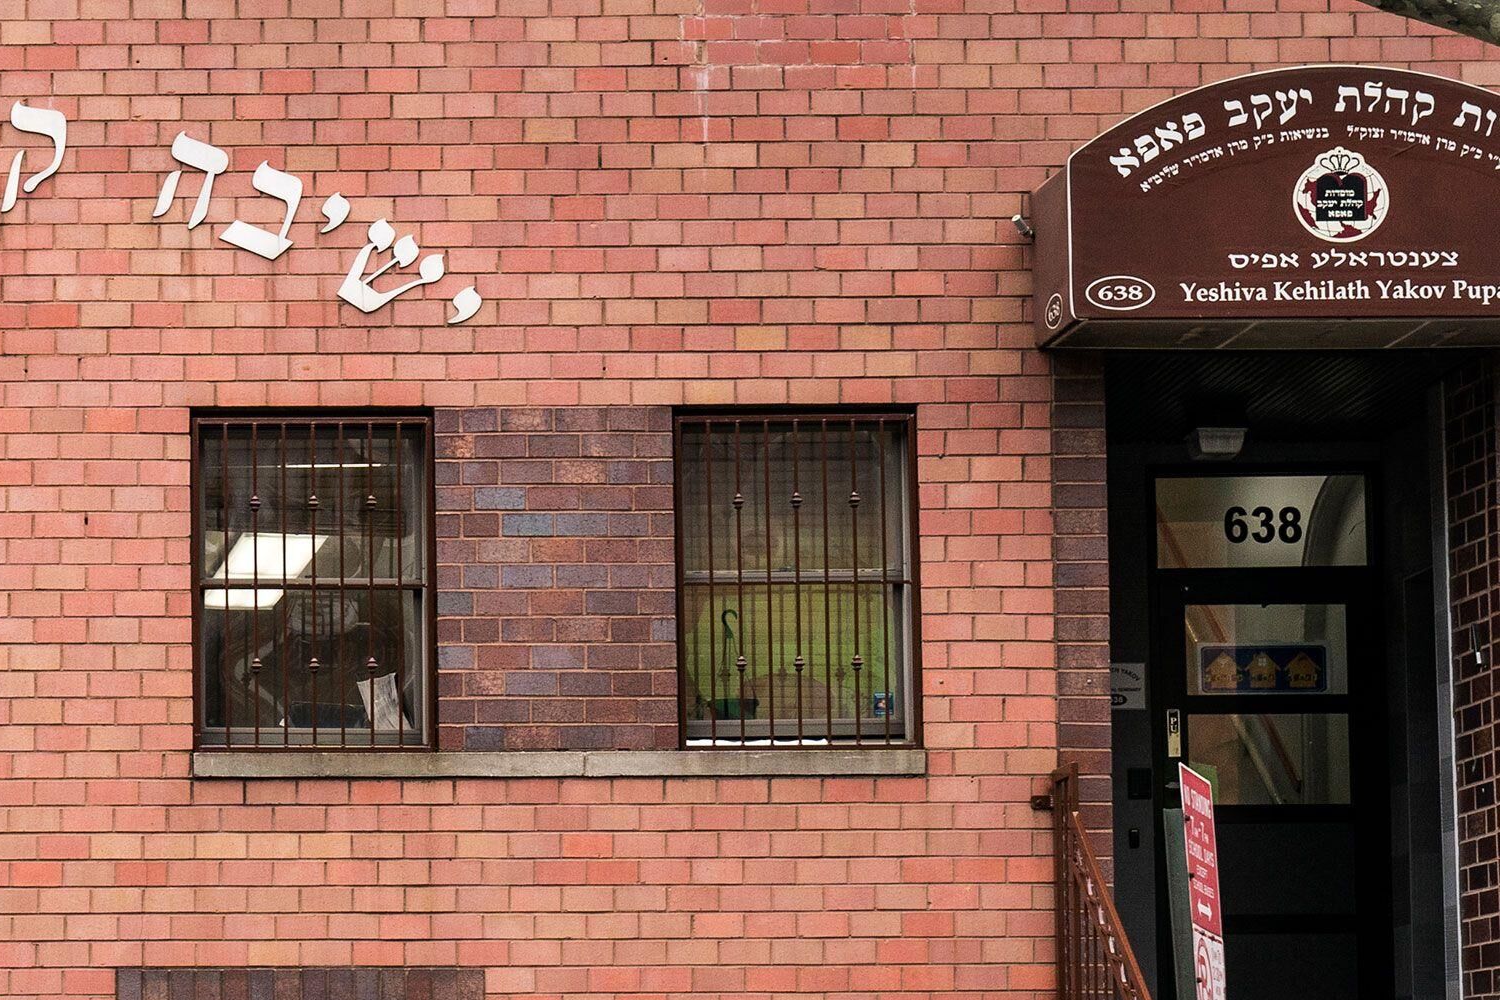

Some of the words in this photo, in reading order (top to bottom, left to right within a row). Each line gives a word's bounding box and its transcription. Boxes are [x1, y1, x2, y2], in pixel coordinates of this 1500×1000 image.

[1223, 88, 1312, 130] יעקב
[1334, 81, 1435, 126] קהלת
[1109, 112, 1206, 178] פאפא
[152, 130, 482, 324] ישיבה
[1228, 252, 1299, 269] אפיס
[1310, 248, 1460, 268] צענטראלע
[1098, 285, 1143, 300] 638
[1180, 282, 1268, 301] Yeshiva
[1273, 280, 1370, 300] Kehilath
[1375, 279, 1446, 299] Yakov
[1224, 506, 1302, 543] 638
